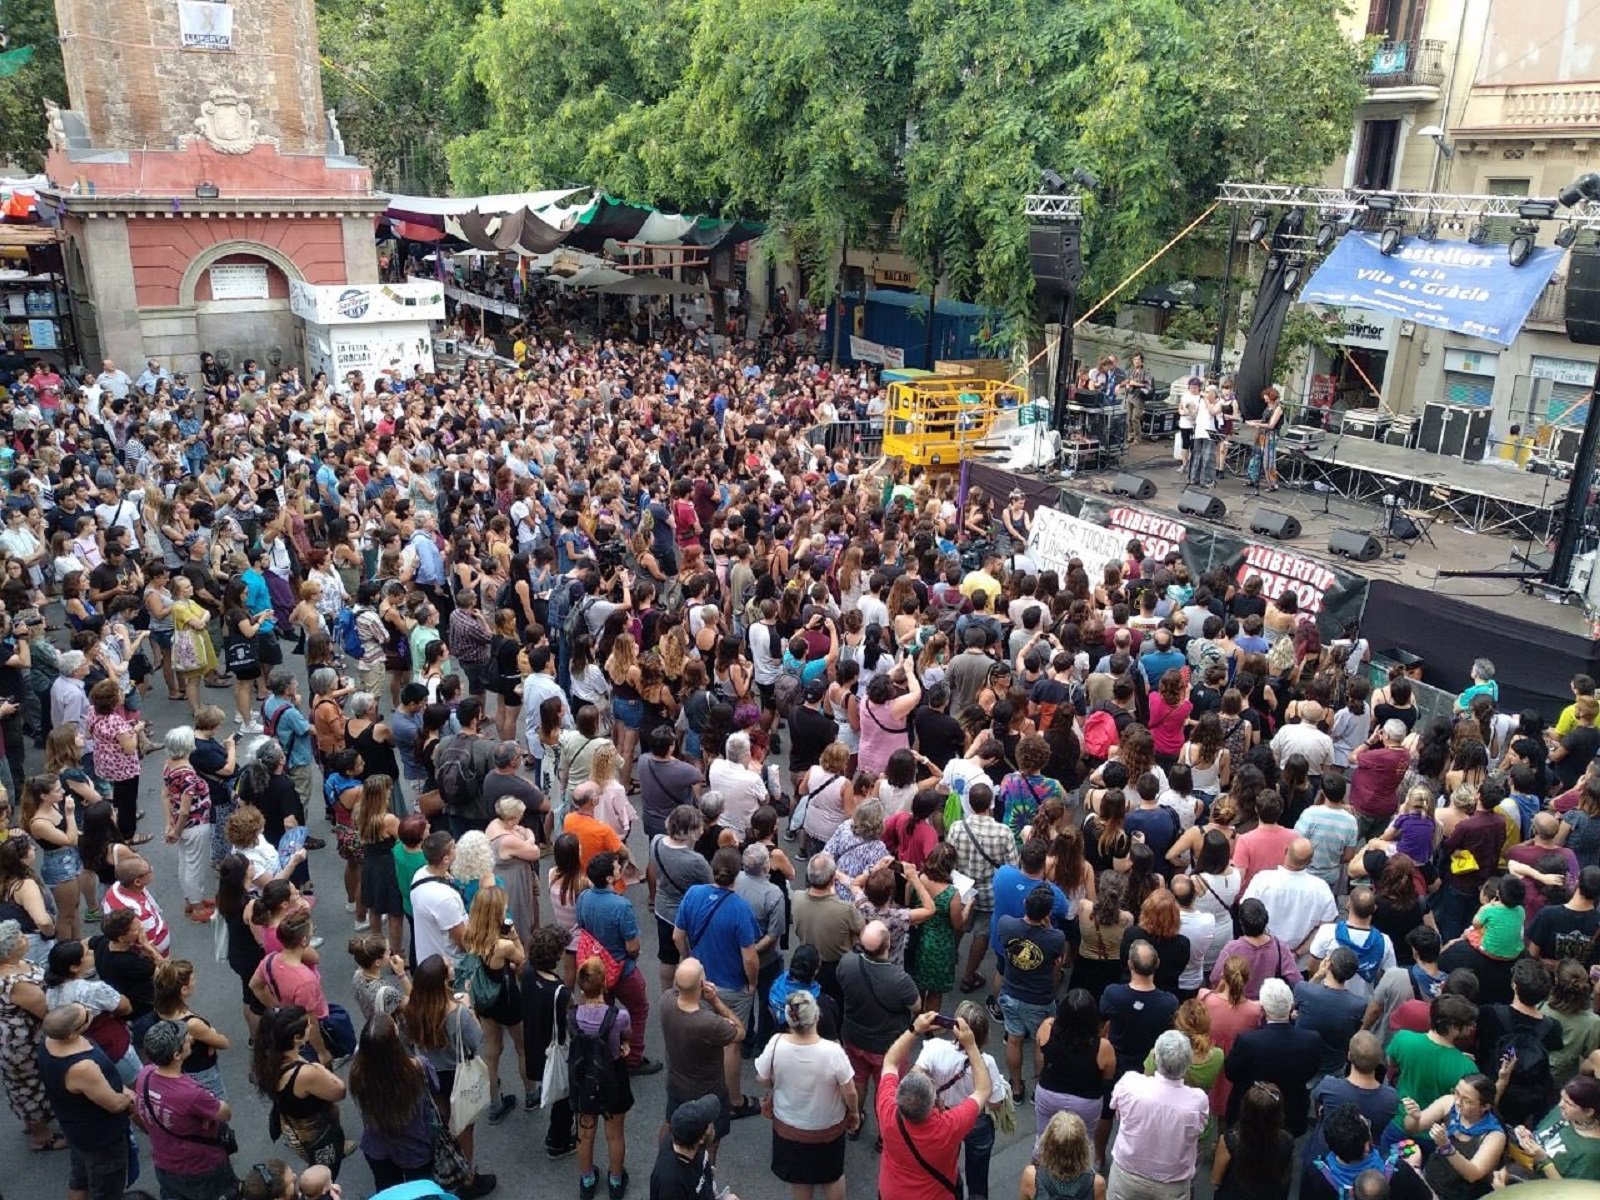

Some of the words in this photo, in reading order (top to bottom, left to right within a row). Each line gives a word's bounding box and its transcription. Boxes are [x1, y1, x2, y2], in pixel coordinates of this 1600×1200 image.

[1356, 268, 1395, 285] Vila
[1398, 279, 1418, 291] de
[1421, 282, 1491, 302] Gràcia
[1409, 266, 1431, 279] de
[1431, 269, 1446, 281] la
[1112, 508, 1186, 543] LLIBERTAT
[1246, 547, 1335, 592] LLIBERTAT
